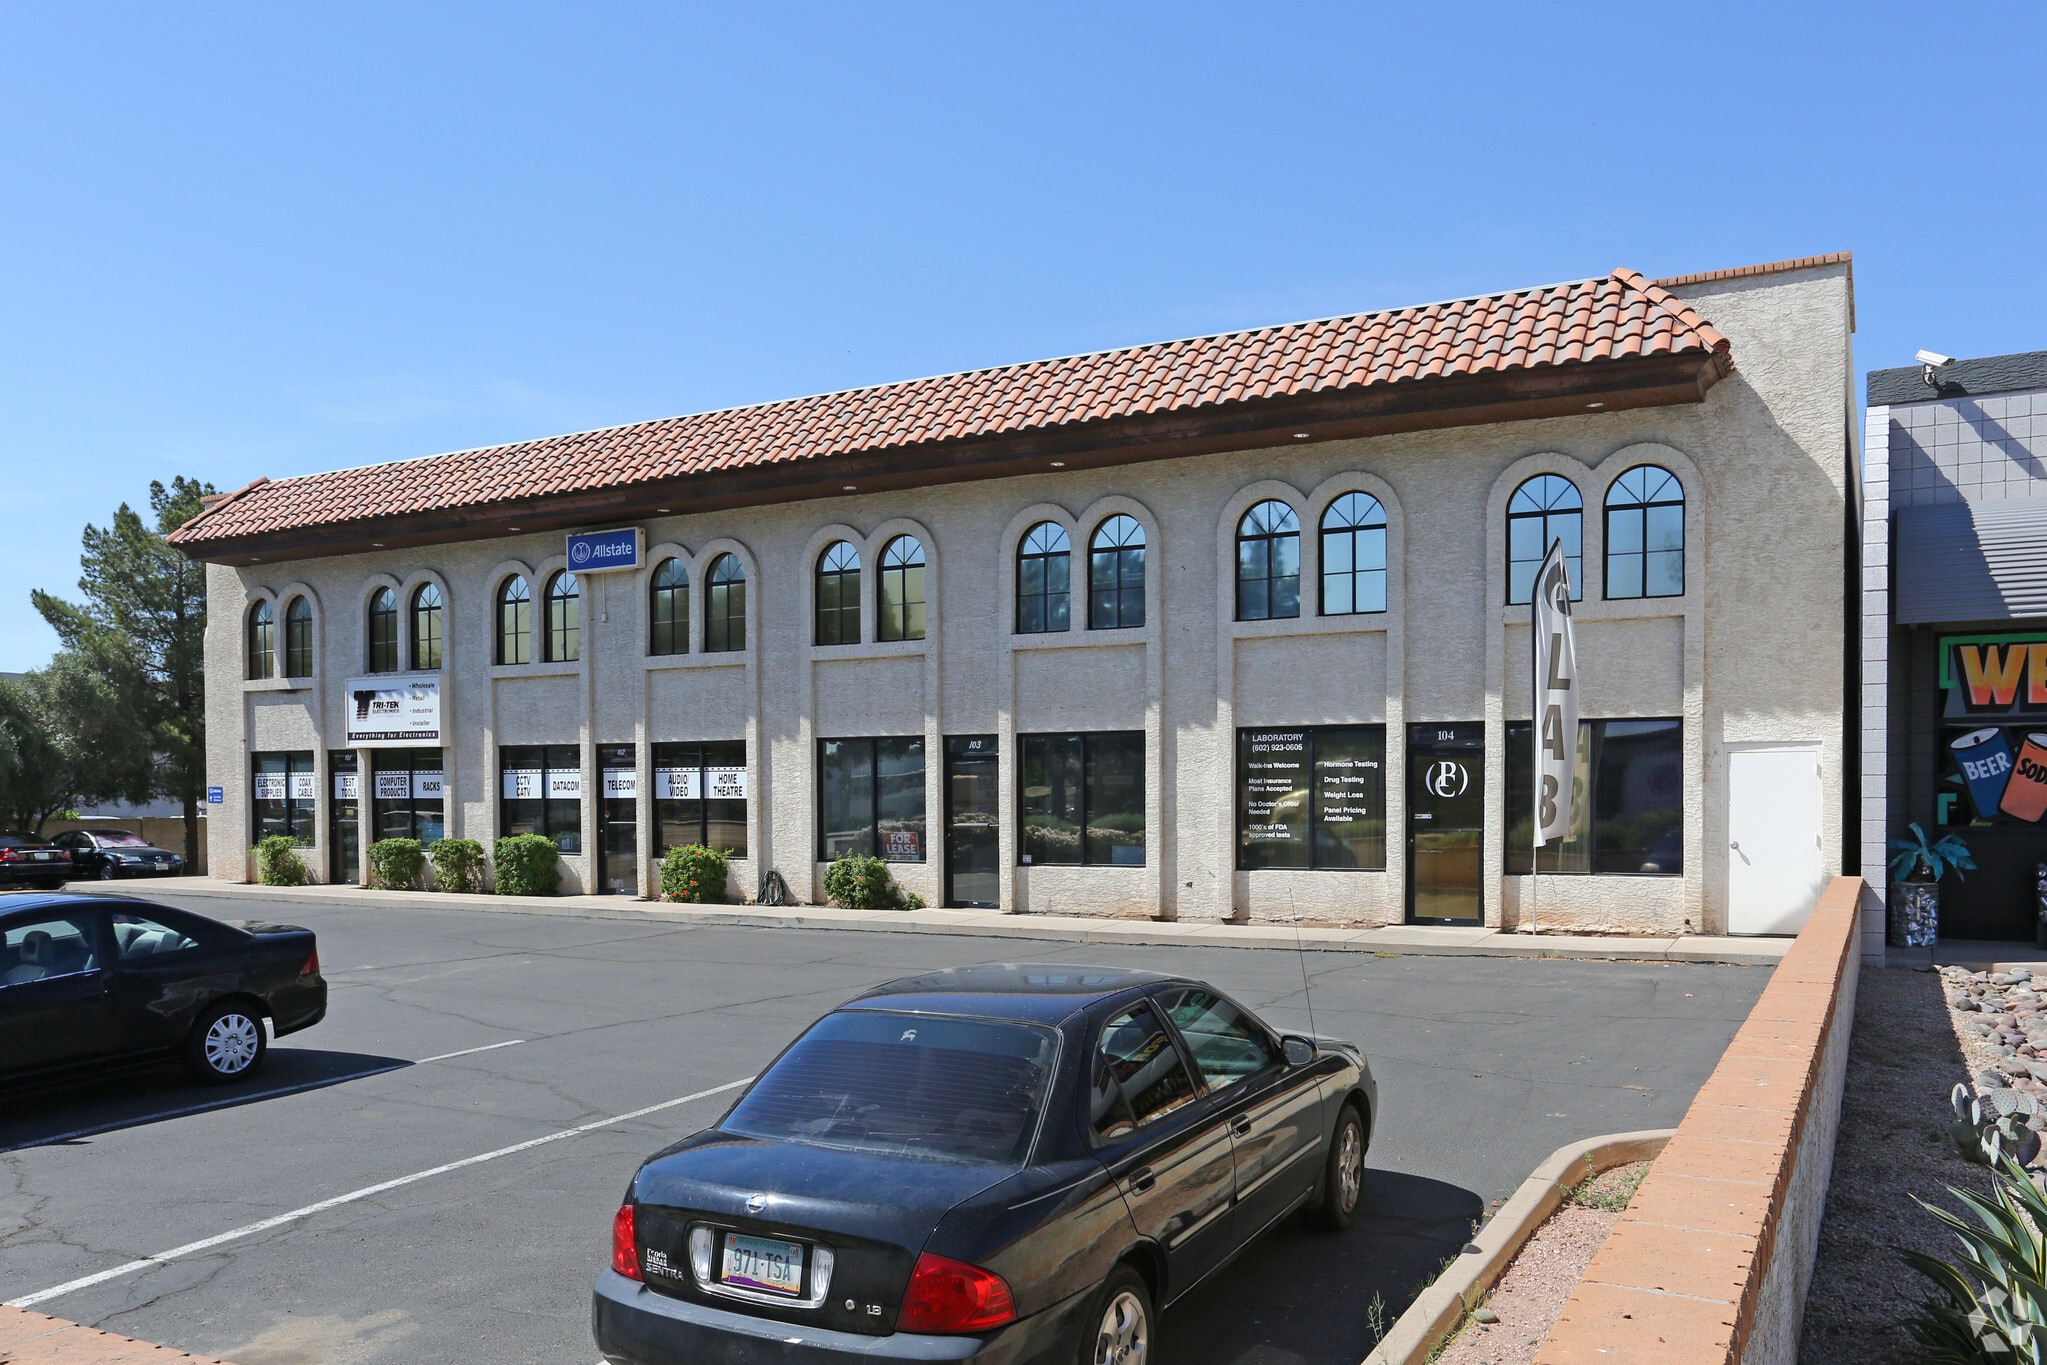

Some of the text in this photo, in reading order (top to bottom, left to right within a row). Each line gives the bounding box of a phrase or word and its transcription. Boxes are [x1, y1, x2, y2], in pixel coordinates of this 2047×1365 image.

[592, 542, 632, 559] Allstate
[372, 701, 400, 709] TRI-TEK
[352, 730, 436, 740] Everything for Electronics
[1252, 733, 1304, 742] LABORATORY
[1437, 730, 1454, 740] 104
[969, 740, 982, 749] 103
[1252, 743, 1303, 753] (602) 923-0605
[1353, 760, 1378, 769] Testing
[1962, 751, 2012, 781] BEER
[2016, 757, 2047, 786] SOD
[257, 778, 286, 787] ELECTRONIC
[298, 778, 312, 787] COAX
[342, 777, 355, 787] TEST
[379, 777, 408, 787] COMPUTER
[516, 776, 531, 786] CCTV
[668, 774, 689, 784] AUDIO
[718, 773, 738, 784] HOME
[1323, 776, 1365, 784] Drug Testing
[422, 781, 441, 791] RACKS
[552, 781, 580, 791] DATACOM
[607, 780, 636, 790] TELECOM
[1265, 785, 1293, 793] Accepted
[260, 788, 283, 797] SUPPLIES
[297, 788, 313, 797] CABLE
[341, 788, 357, 797] TOOLS
[380, 787, 407, 797] PRODUCTS
[516, 787, 531, 797] CATV
[669, 786, 689, 797] VIDEO
[713, 785, 743, 797] THEATRE
[1323, 791, 1347, 800] Weight
[1342, 806, 1367, 815] Pricing
[890, 833, 911, 843] FOR
[886, 844, 917, 854] LEASE
[645, 1262, 685, 1281] SENTRA
